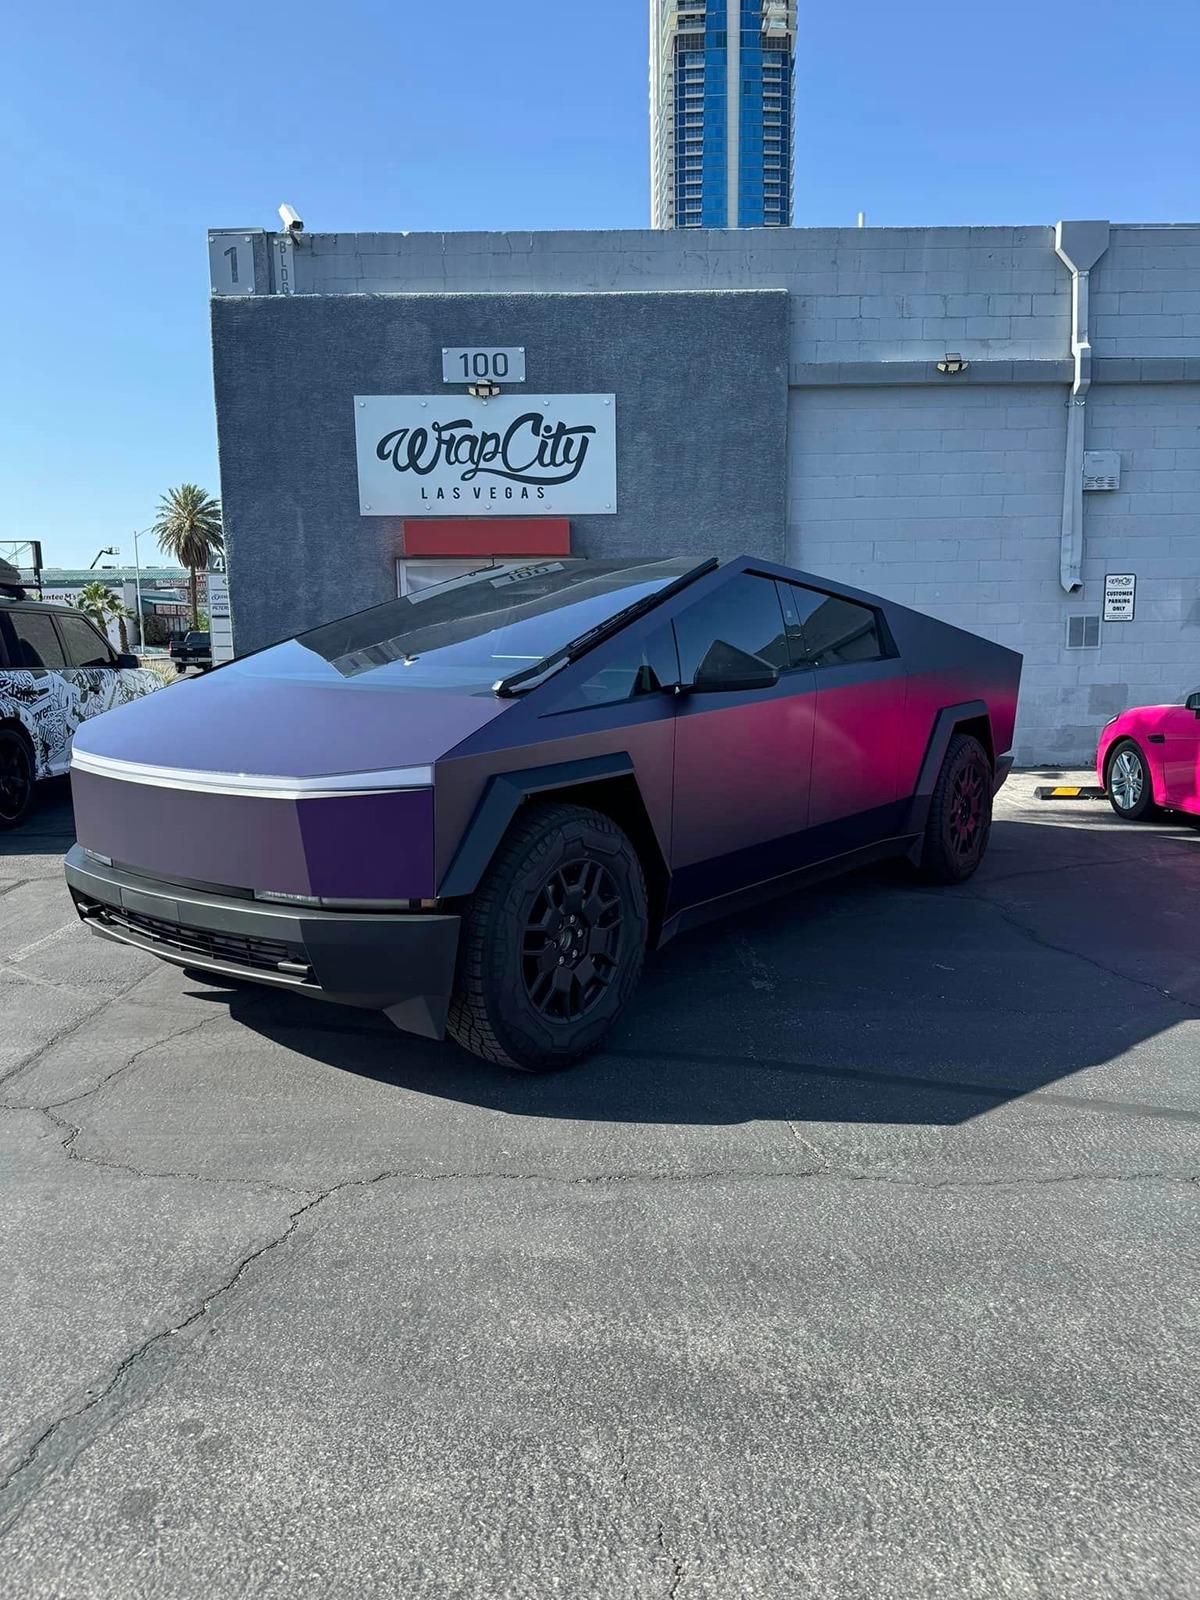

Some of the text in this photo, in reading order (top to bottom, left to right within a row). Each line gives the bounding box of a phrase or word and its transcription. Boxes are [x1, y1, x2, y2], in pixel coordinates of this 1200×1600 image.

[224, 246, 239, 283] 1
[279, 240, 289, 294] BLDG
[459, 352, 509, 377] 100
[421, 486, 545, 499] LAS VEGAS
[213, 557, 225, 572] 4
